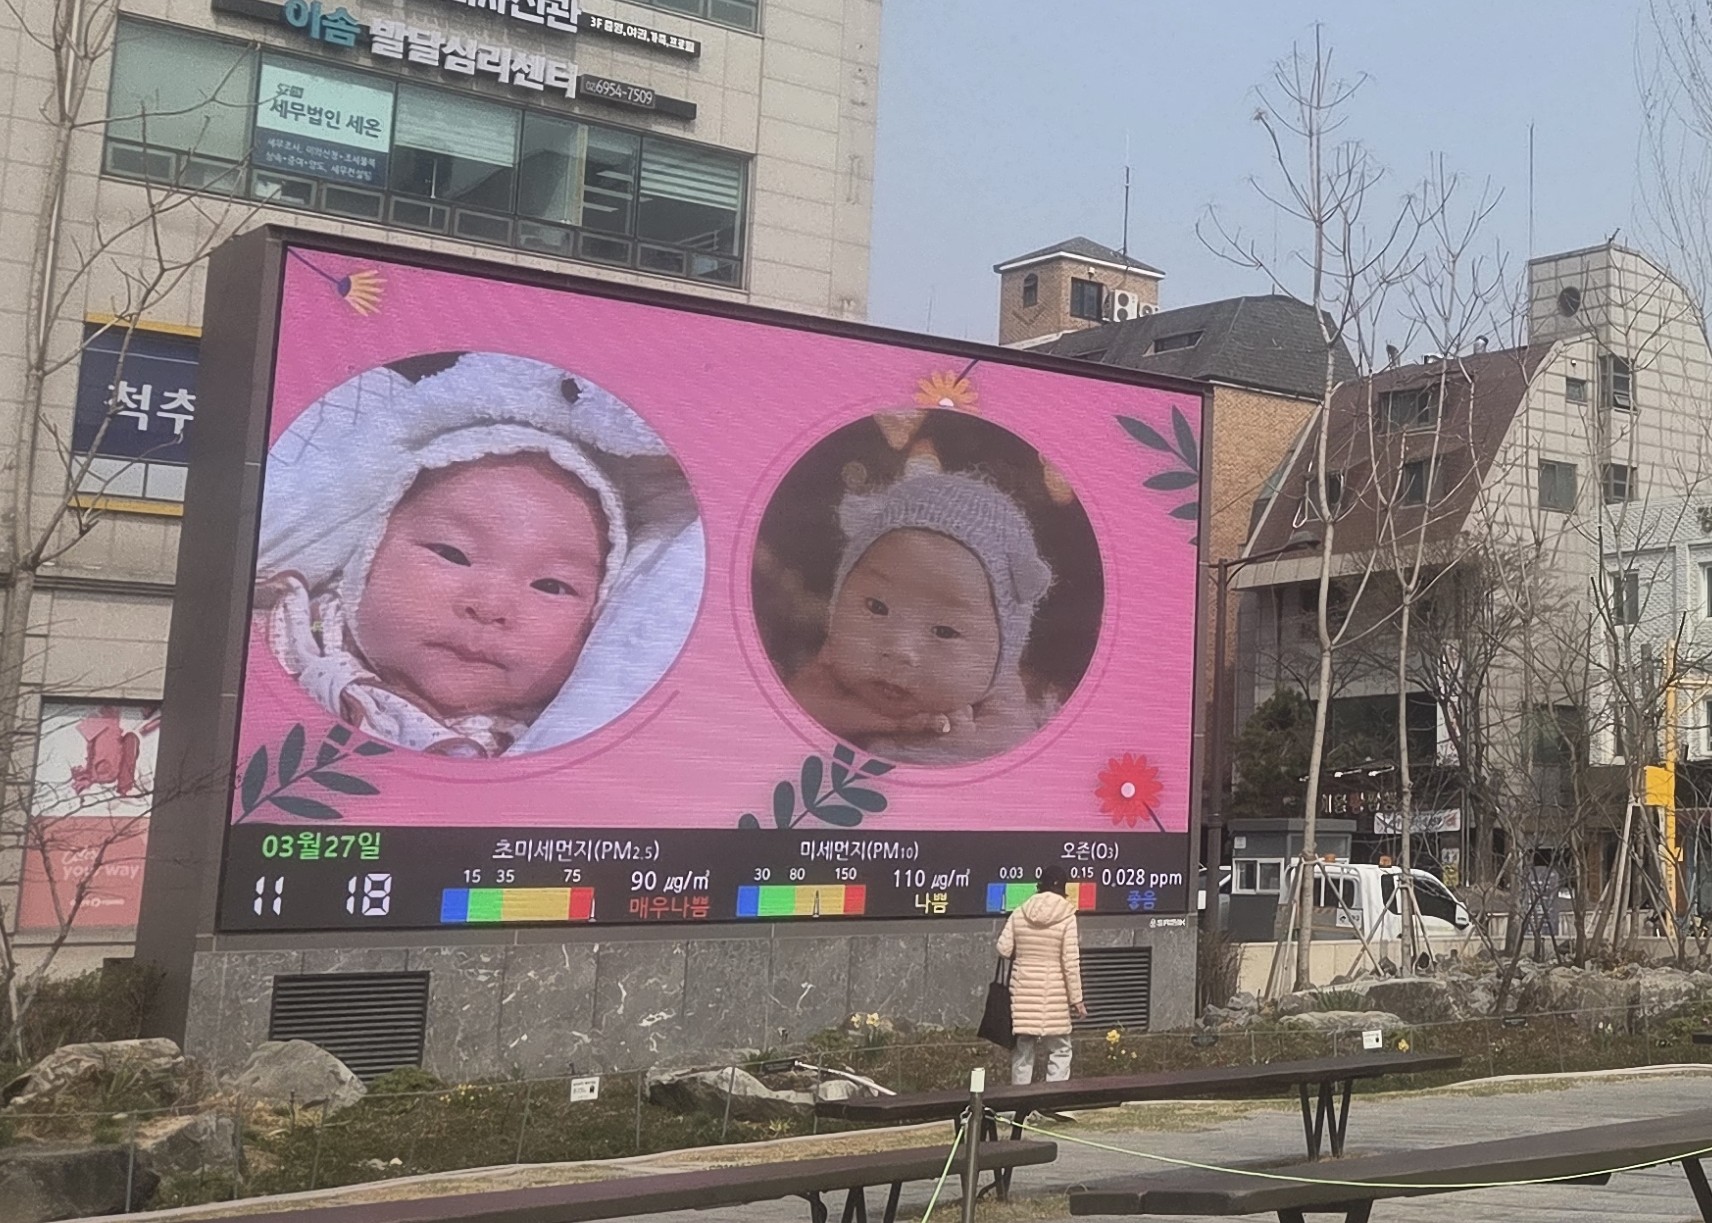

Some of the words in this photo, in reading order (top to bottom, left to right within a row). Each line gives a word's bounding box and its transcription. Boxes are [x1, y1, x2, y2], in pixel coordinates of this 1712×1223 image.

[454, 0, 578, 33] 진관
[590, 16, 603, 29] 3F
[285, 0, 361, 47] 이솜
[370, 18, 579, 99] 발달심리센터
[269, 98, 341, 130] 세무법인
[346, 114, 382, 139] 세온
[104, 380, 197, 435] 척추
[261, 831, 381, 861] 03월27일
[492, 838, 660, 863] 초미세먼지(PM2.5)
[799, 840, 919, 862] 미세먼지(PM10)
[1060, 841, 1119, 862] 오존(O3)
[105, 864, 140, 880] way
[463, 869, 482, 884] 15
[496, 868, 516, 884] 35
[563, 868, 582, 884] 75
[630, 870, 657, 892] 90
[753, 867, 771, 881] 30
[788, 867, 806, 881] 80
[834, 866, 858, 881] 150
[893, 868, 926, 888] 110
[1000, 866, 1024, 880] 0.03
[1070, 866, 1095, 879] 0.15
[1101, 868, 1146, 887] 0.028
[1149, 871, 1183, 888] ppm
[253, 875, 285, 917] 11
[345, 873, 393, 916] 18
[914, 892, 949, 914] 나쁨
[1126, 889, 1158, 911] 좋음
[629, 895, 712, 919] 매우나쁨
